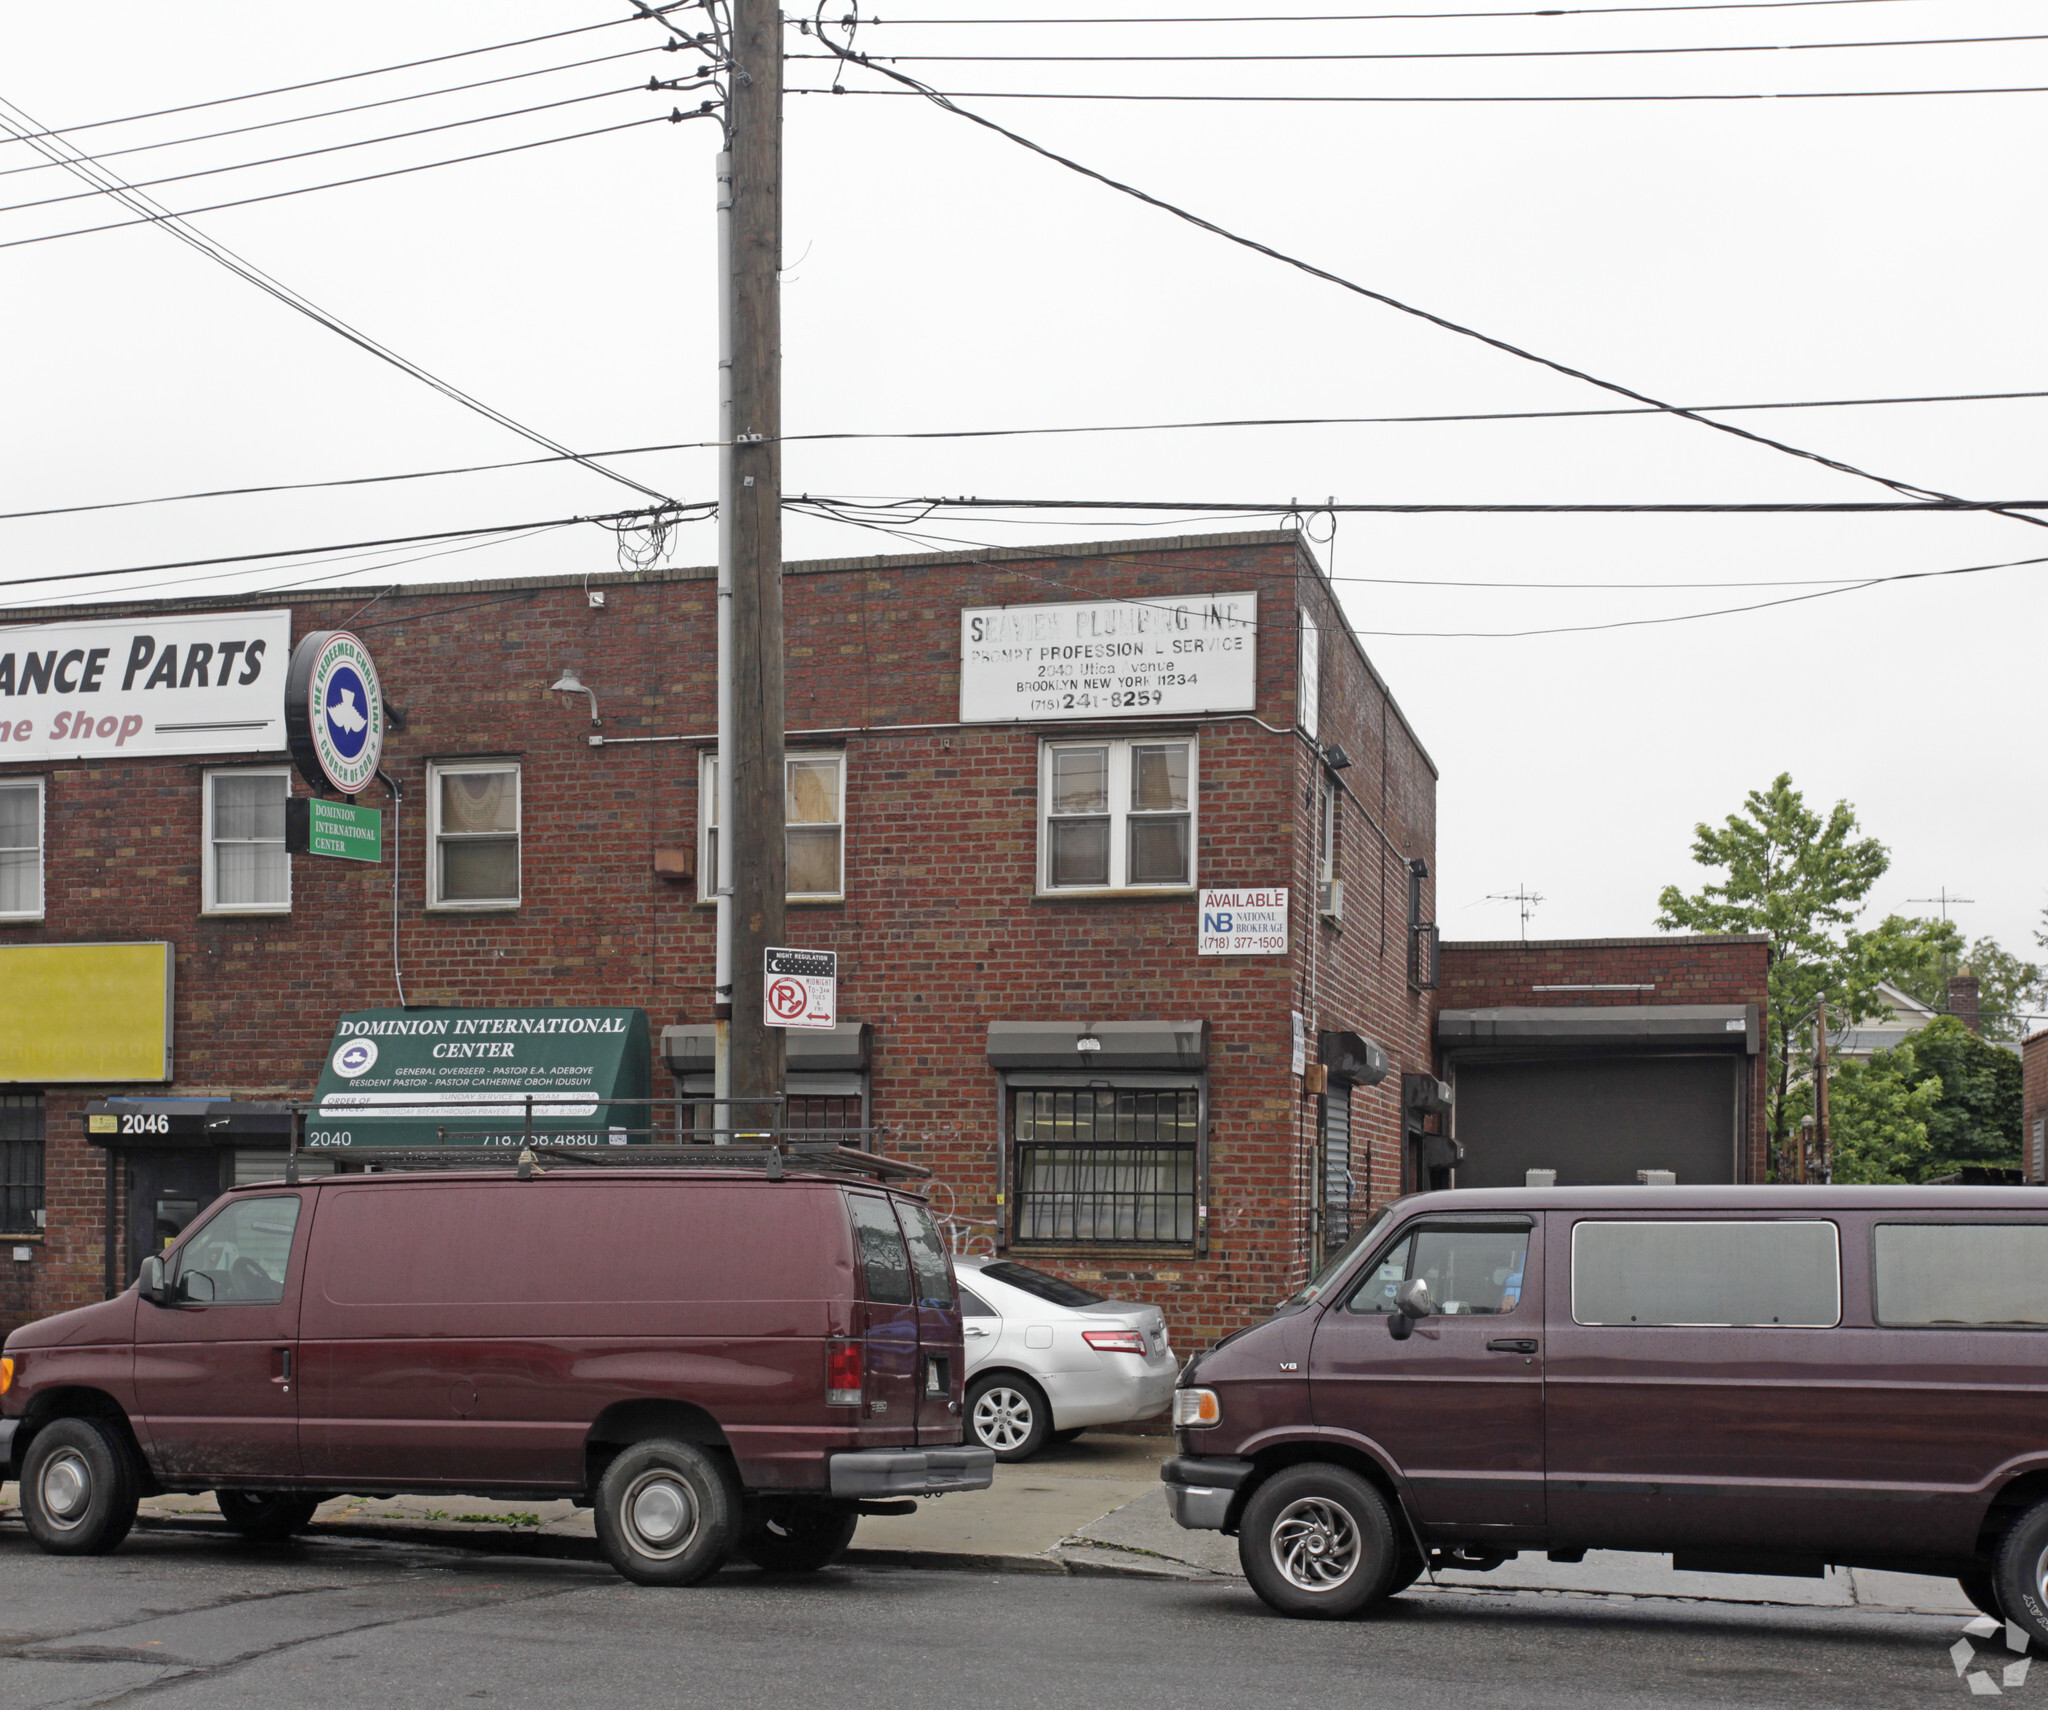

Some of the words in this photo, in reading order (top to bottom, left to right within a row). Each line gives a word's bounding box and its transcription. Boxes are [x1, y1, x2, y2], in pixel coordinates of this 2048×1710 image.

[1040, 642, 1164, 660] PROFESSIONL
[1172, 637, 1242, 654] SERVICE
[121, 635, 267, 691] PARTS
[317, 642, 355, 682] REDEEMED
[1080, 663, 1115, 675] Utica
[1017, 679, 1078, 692] BROOKLYN
[1084, 678, 1111, 690] NEW
[1118, 676, 1150, 688] YORK
[1158, 673, 1198, 685] 11234
[314, 684, 322, 716] THE
[356, 651, 379, 734] CHRISTIAN
[1031, 698, 1060, 711] (718)
[49, 711, 144, 747] Shop
[321, 739, 348, 782] CHURCH
[350, 768, 359, 782] OF
[359, 753, 373, 778] GOD
[315, 804, 356, 821] DOMINION
[315, 820, 376, 841] INTERNATIONAL
[315, 837, 345, 852] CENTER
[1205, 893, 1284, 908] AVAILABLE
[1204, 912, 1233, 933] NB
[1236, 912, 1276, 921] NATIONAL
[1236, 923, 1284, 933] BROKERAGE
[1204, 936, 1230, 950] (718)
[1234, 936, 1284, 949] 377-1500
[794, 953, 829, 961] REGULATION
[806, 978, 831, 986] MIDNIGHT
[338, 1020, 450, 1036] DOMINION
[453, 1018, 627, 1035] INTERNATIONAL
[432, 1042, 515, 1058] CENTER
[395, 1068, 436, 1076] GENERAL
[439, 1067, 485, 1076] OVERSEER
[493, 1067, 529, 1075] PASTOR
[530, 1067, 547, 1075] E.A.
[550, 1066, 594, 1075] ADEBOYE
[349, 1079, 391, 1087] RESIDENT
[392, 1079, 428, 1087] PASTOR
[435, 1078, 469, 1087] PASTOR
[472, 1078, 522, 1086] CATHERINE
[524, 1078, 553, 1086] OBOH
[555, 1078, 591, 1086] IDUSUYI
[328, 1097, 356, 1105] ORDER
[122, 1114, 169, 1134] 2046
[310, 1131, 352, 1147] 2040
